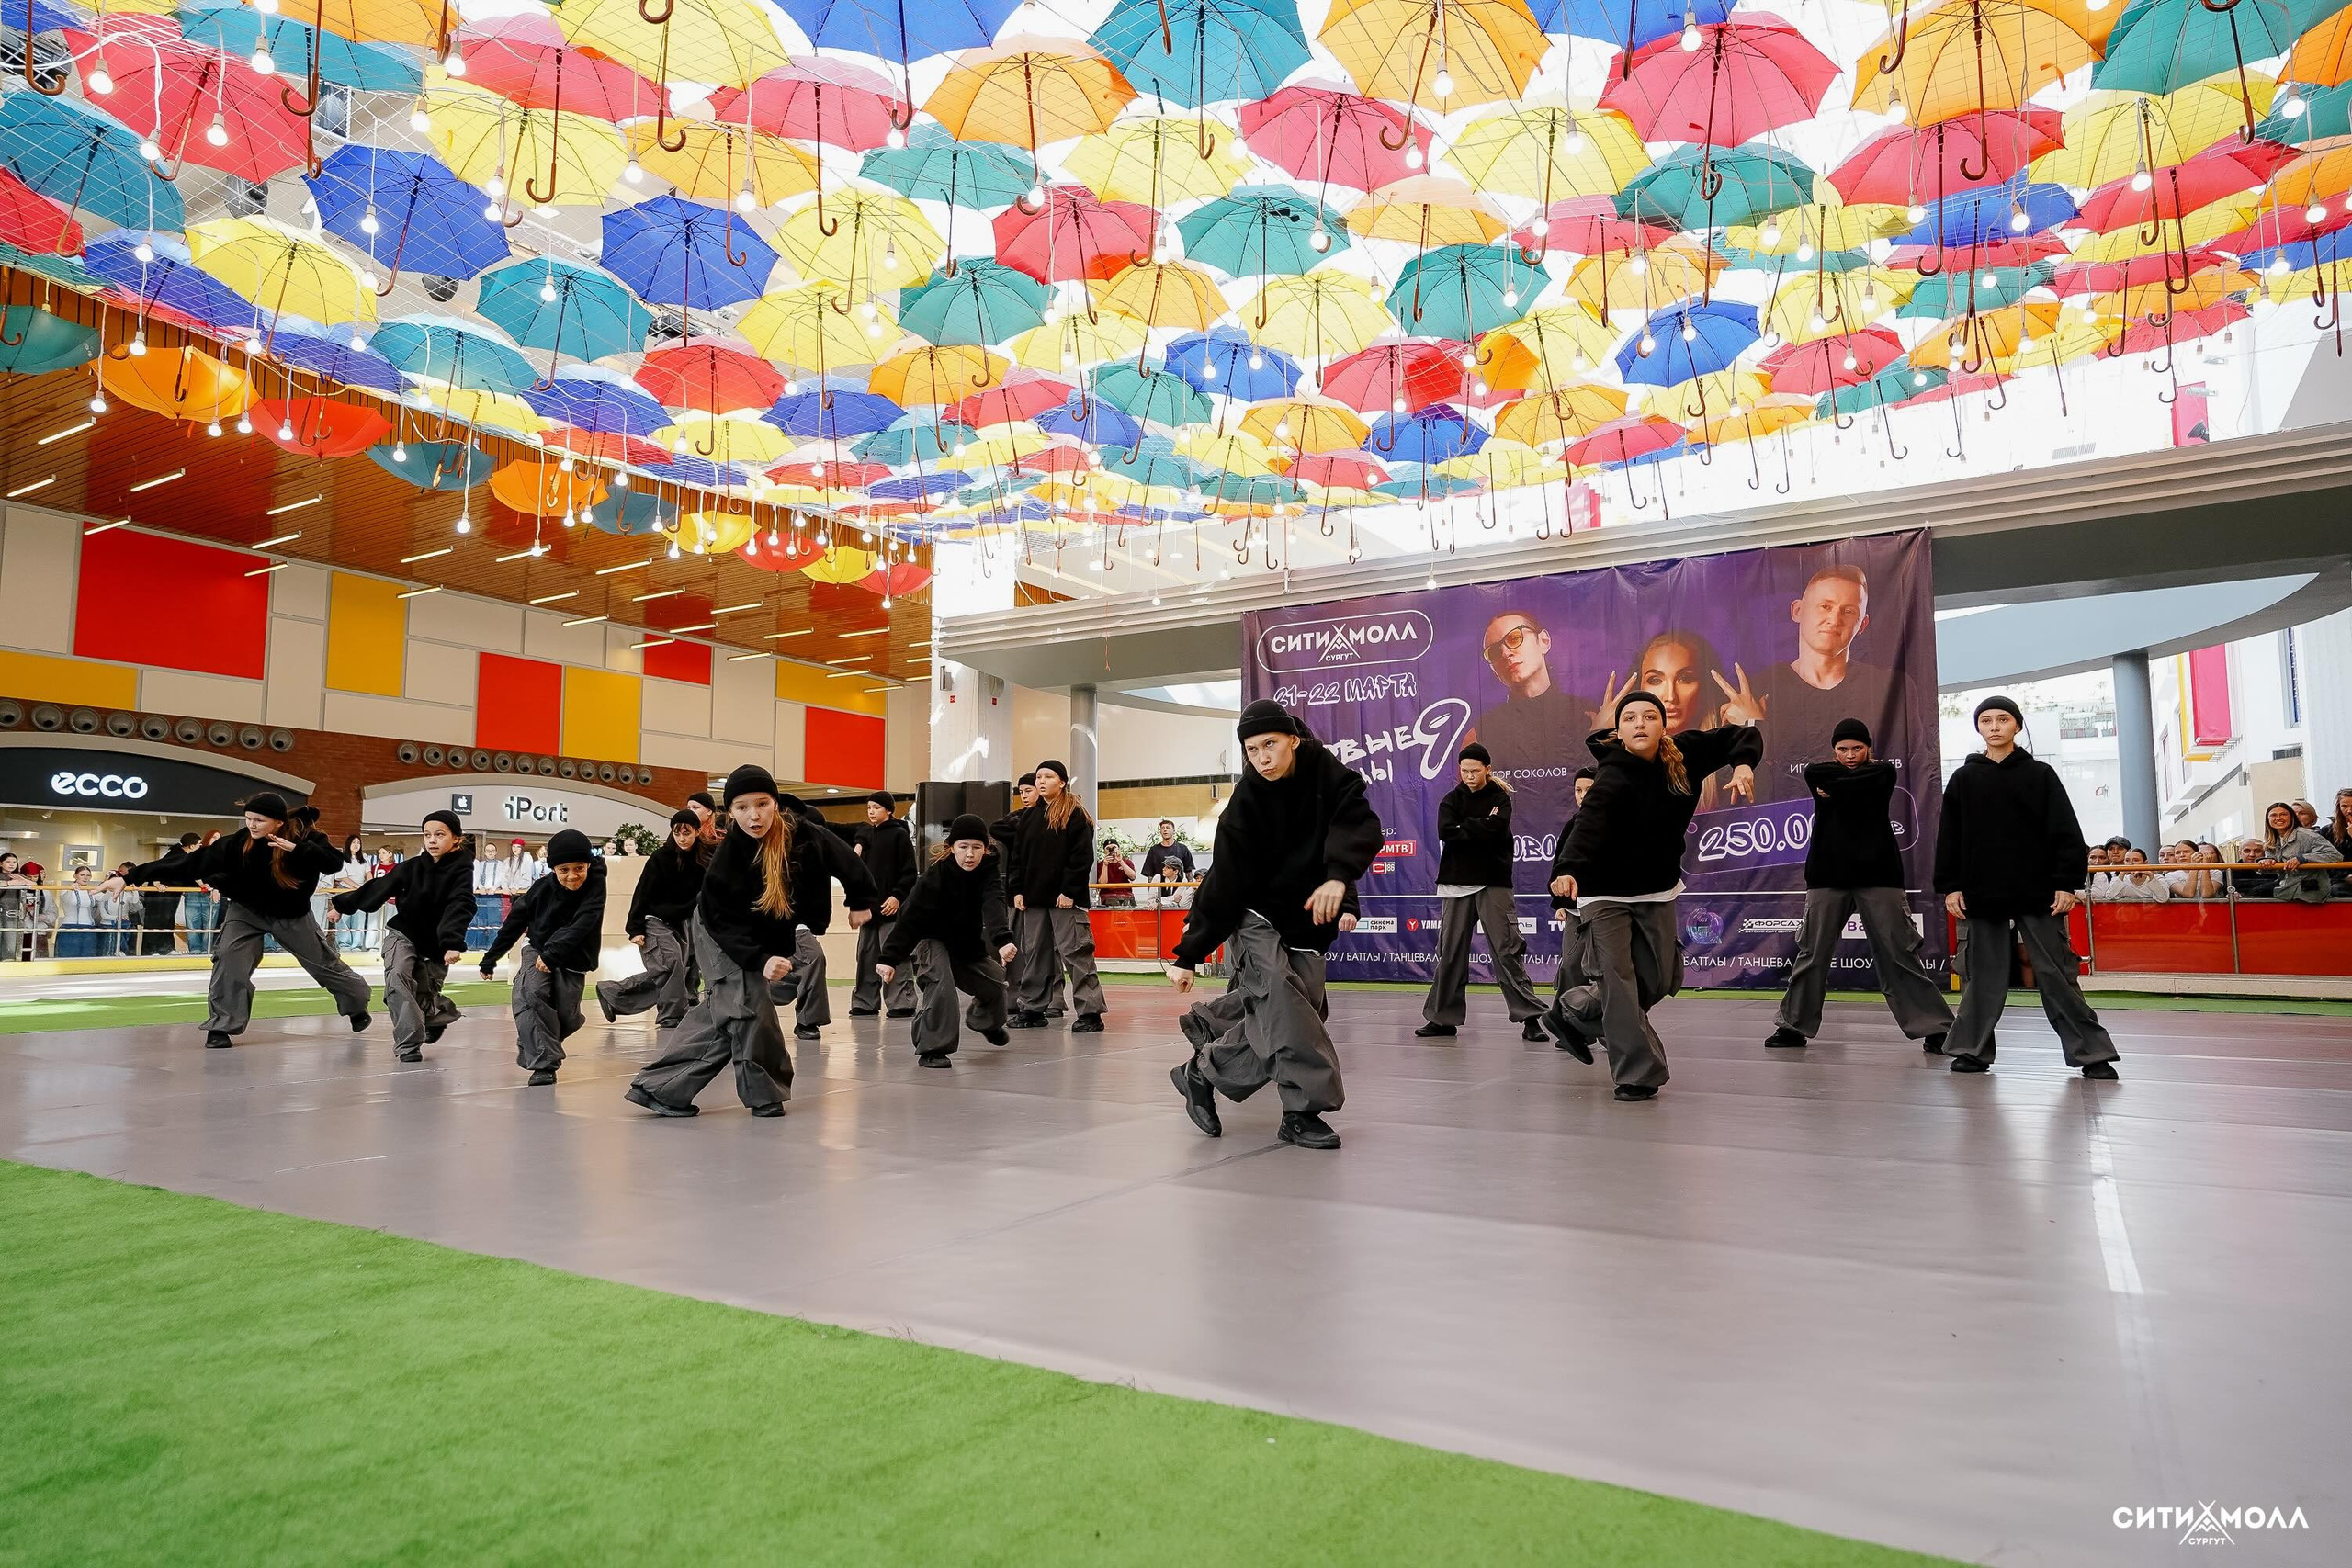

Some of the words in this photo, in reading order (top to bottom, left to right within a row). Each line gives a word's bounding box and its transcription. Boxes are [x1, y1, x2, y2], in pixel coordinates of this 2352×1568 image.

[1325, 652, 1354, 662] СУРГУТ
[1273, 682, 1341, 708] 21-22
[1344, 671, 1418, 703] МАРТА
[51, 772, 148, 799] ecco
[1492, 770, 1511, 780] ГОР
[1513, 767, 1567, 779] СОКОЛОВ
[504, 795, 568, 823] iPort
[1698, 813, 1815, 861] 250.0
[1325, 952, 1339, 961] ОУ
[1346, 952, 1381, 962] БАТТЛЫ
[1389, 953, 1440, 963] ТАНЦЕВАЛ
[1683, 956, 1726, 967] БАТТЛЫ
[1737, 957, 1793, 969] ТАНЦЕВА
[1840, 957, 1874, 969] ШОУ
